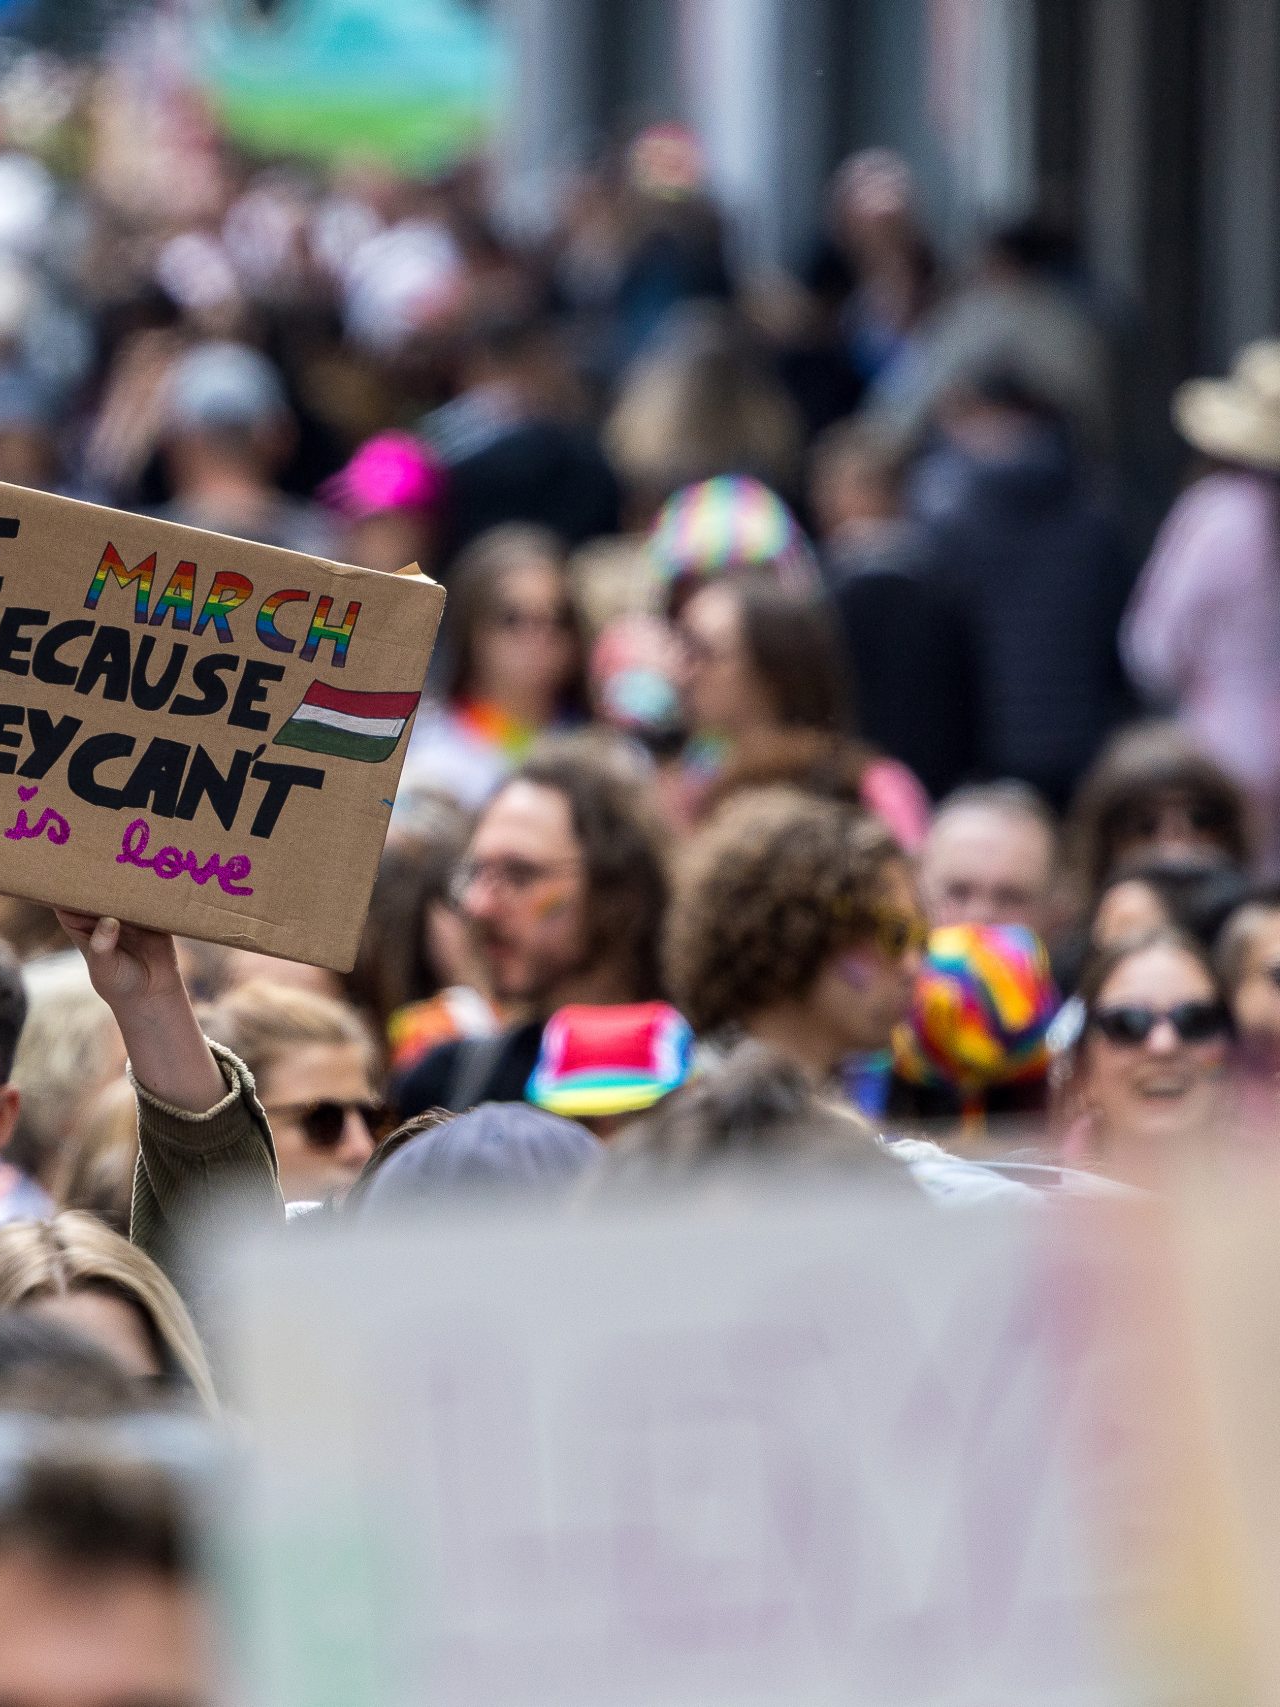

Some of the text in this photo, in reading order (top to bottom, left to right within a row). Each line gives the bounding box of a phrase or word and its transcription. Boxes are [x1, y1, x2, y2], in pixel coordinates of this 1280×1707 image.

[83, 541, 362, 668] MARCH
[4, 786, 70, 844] is
[116, 819, 254, 897] love
